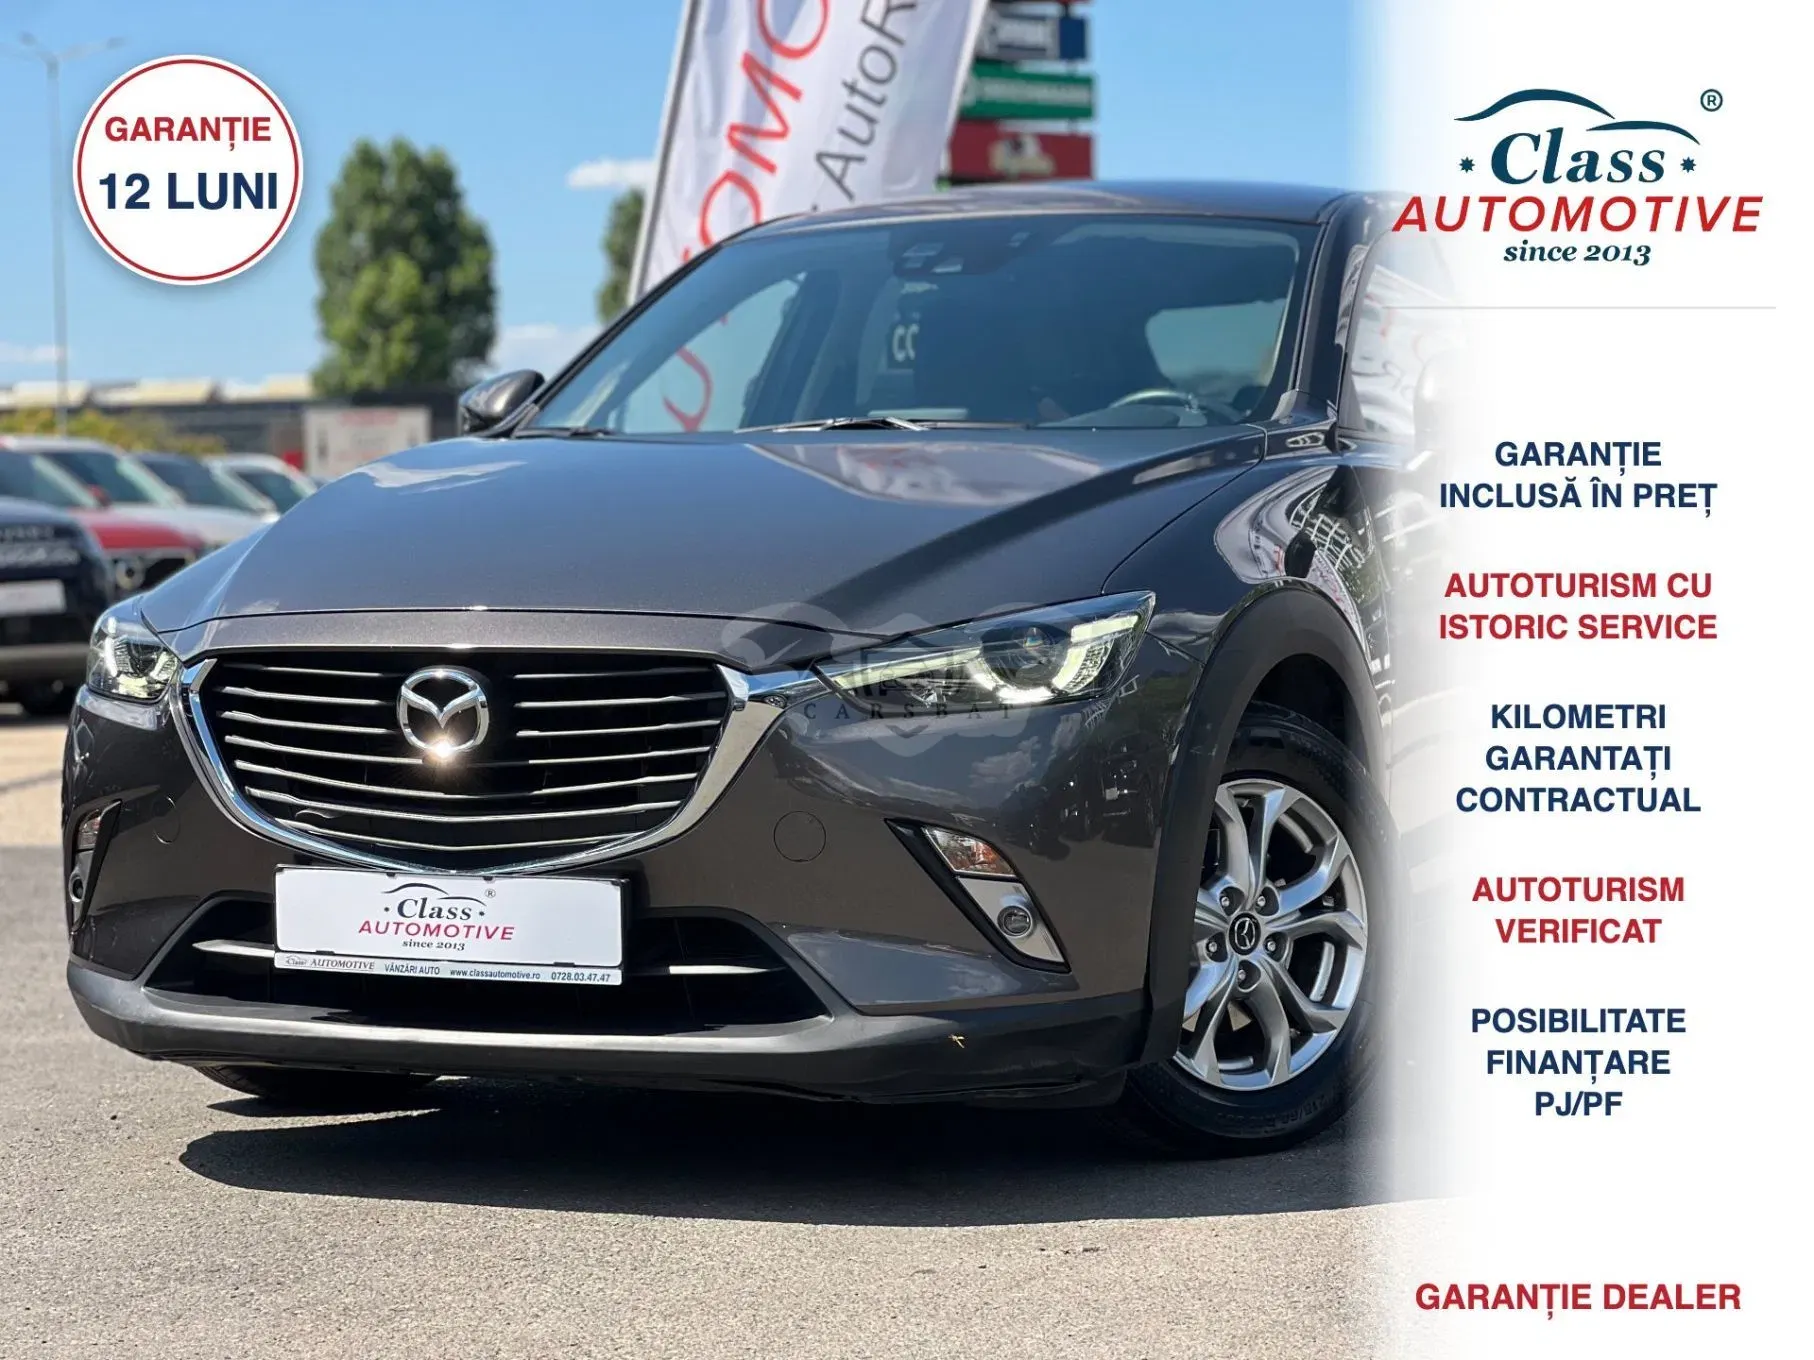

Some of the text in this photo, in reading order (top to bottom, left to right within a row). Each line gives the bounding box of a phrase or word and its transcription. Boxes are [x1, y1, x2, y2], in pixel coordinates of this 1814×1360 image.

[397, 896, 473, 921] Class
[358, 919, 515, 941] AUTOMOTIVE
[402, 938, 466, 951] since 2013
[311, 957, 376, 971] AUTOMOTIVE
[418, 964, 441, 976] AUTO
[449, 967, 542, 981] www.classautomotive.ro
[550, 970, 612, 983] 0728.03.47.47
